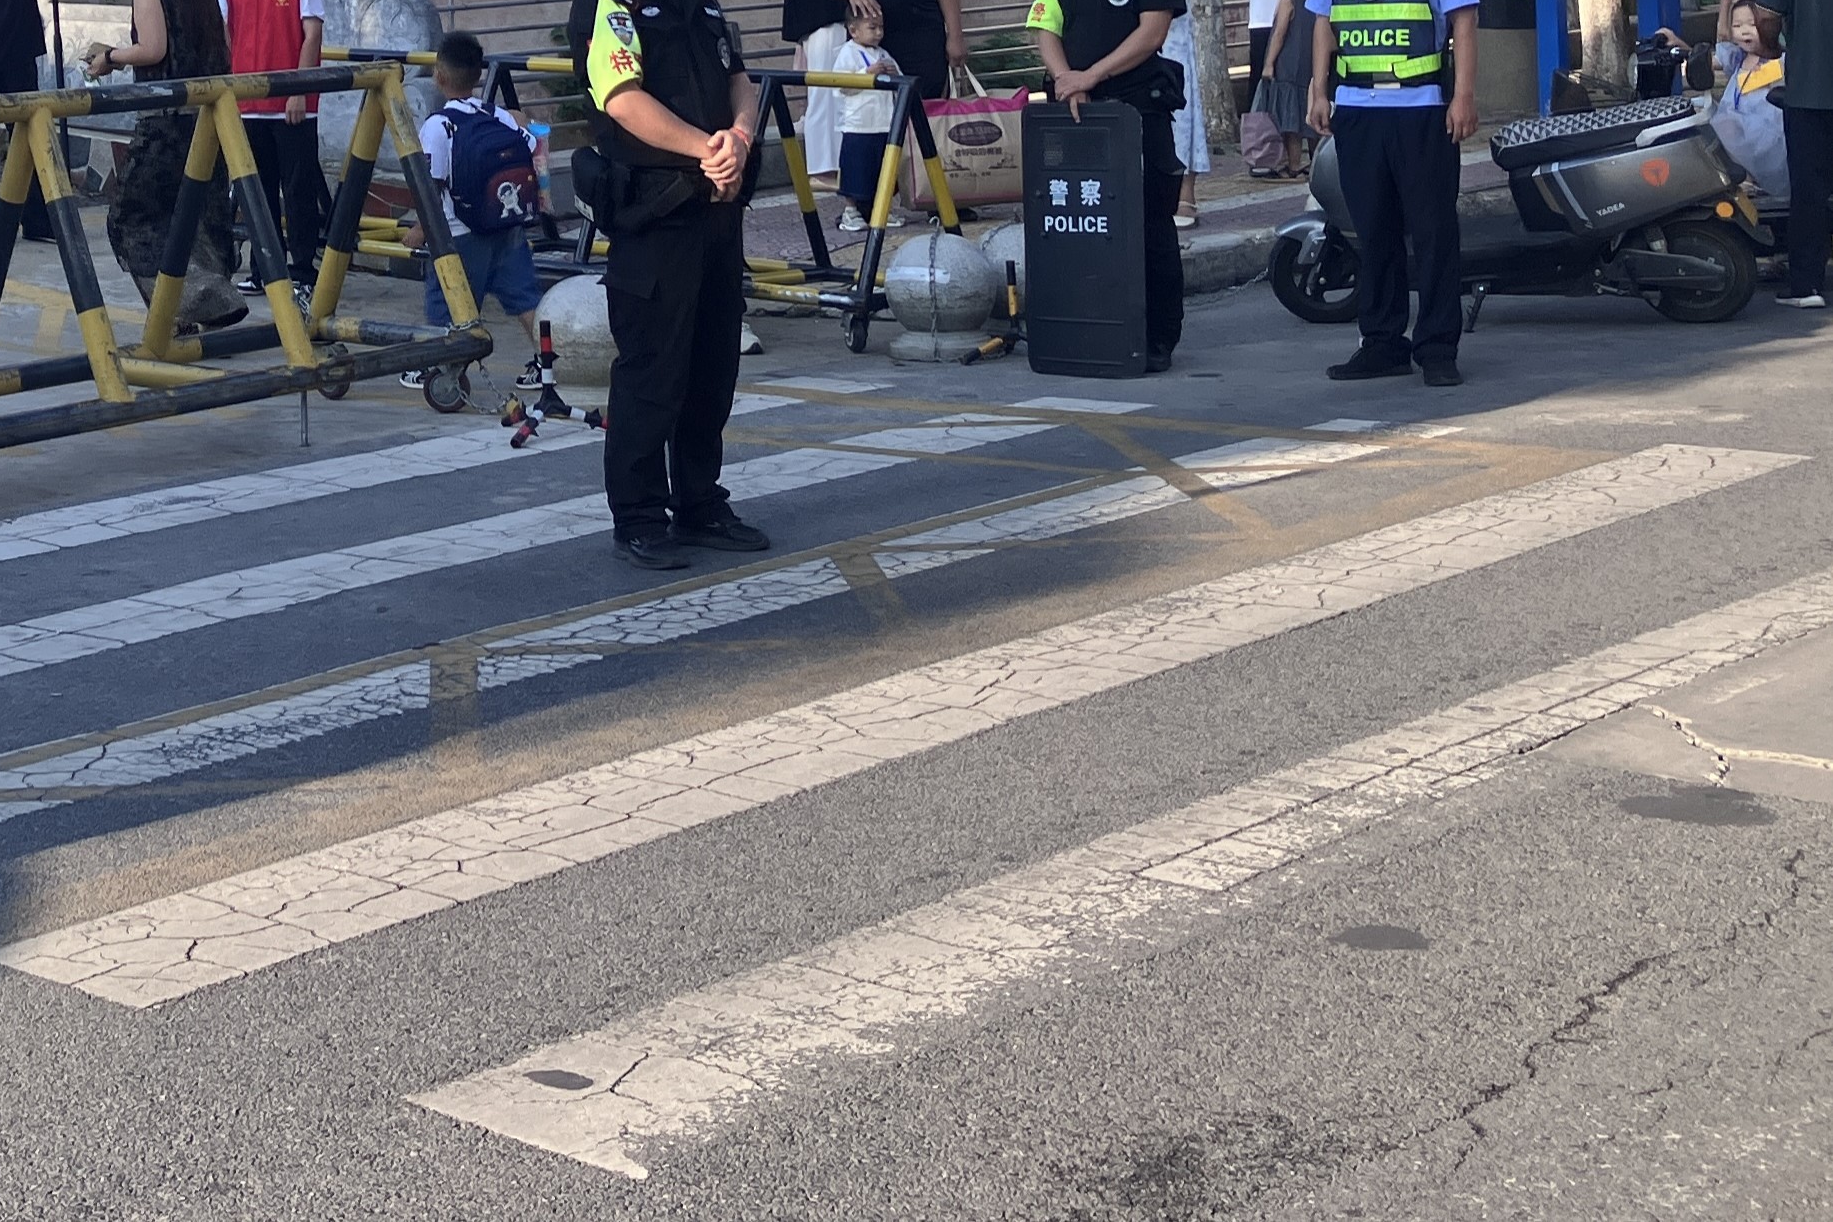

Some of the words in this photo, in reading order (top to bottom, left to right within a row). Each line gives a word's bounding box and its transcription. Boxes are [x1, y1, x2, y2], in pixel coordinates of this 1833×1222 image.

[1339, 29, 1411, 47] POLICE
[1049, 179, 1101, 206] 警察
[1044, 216, 1108, 233] POLICE
